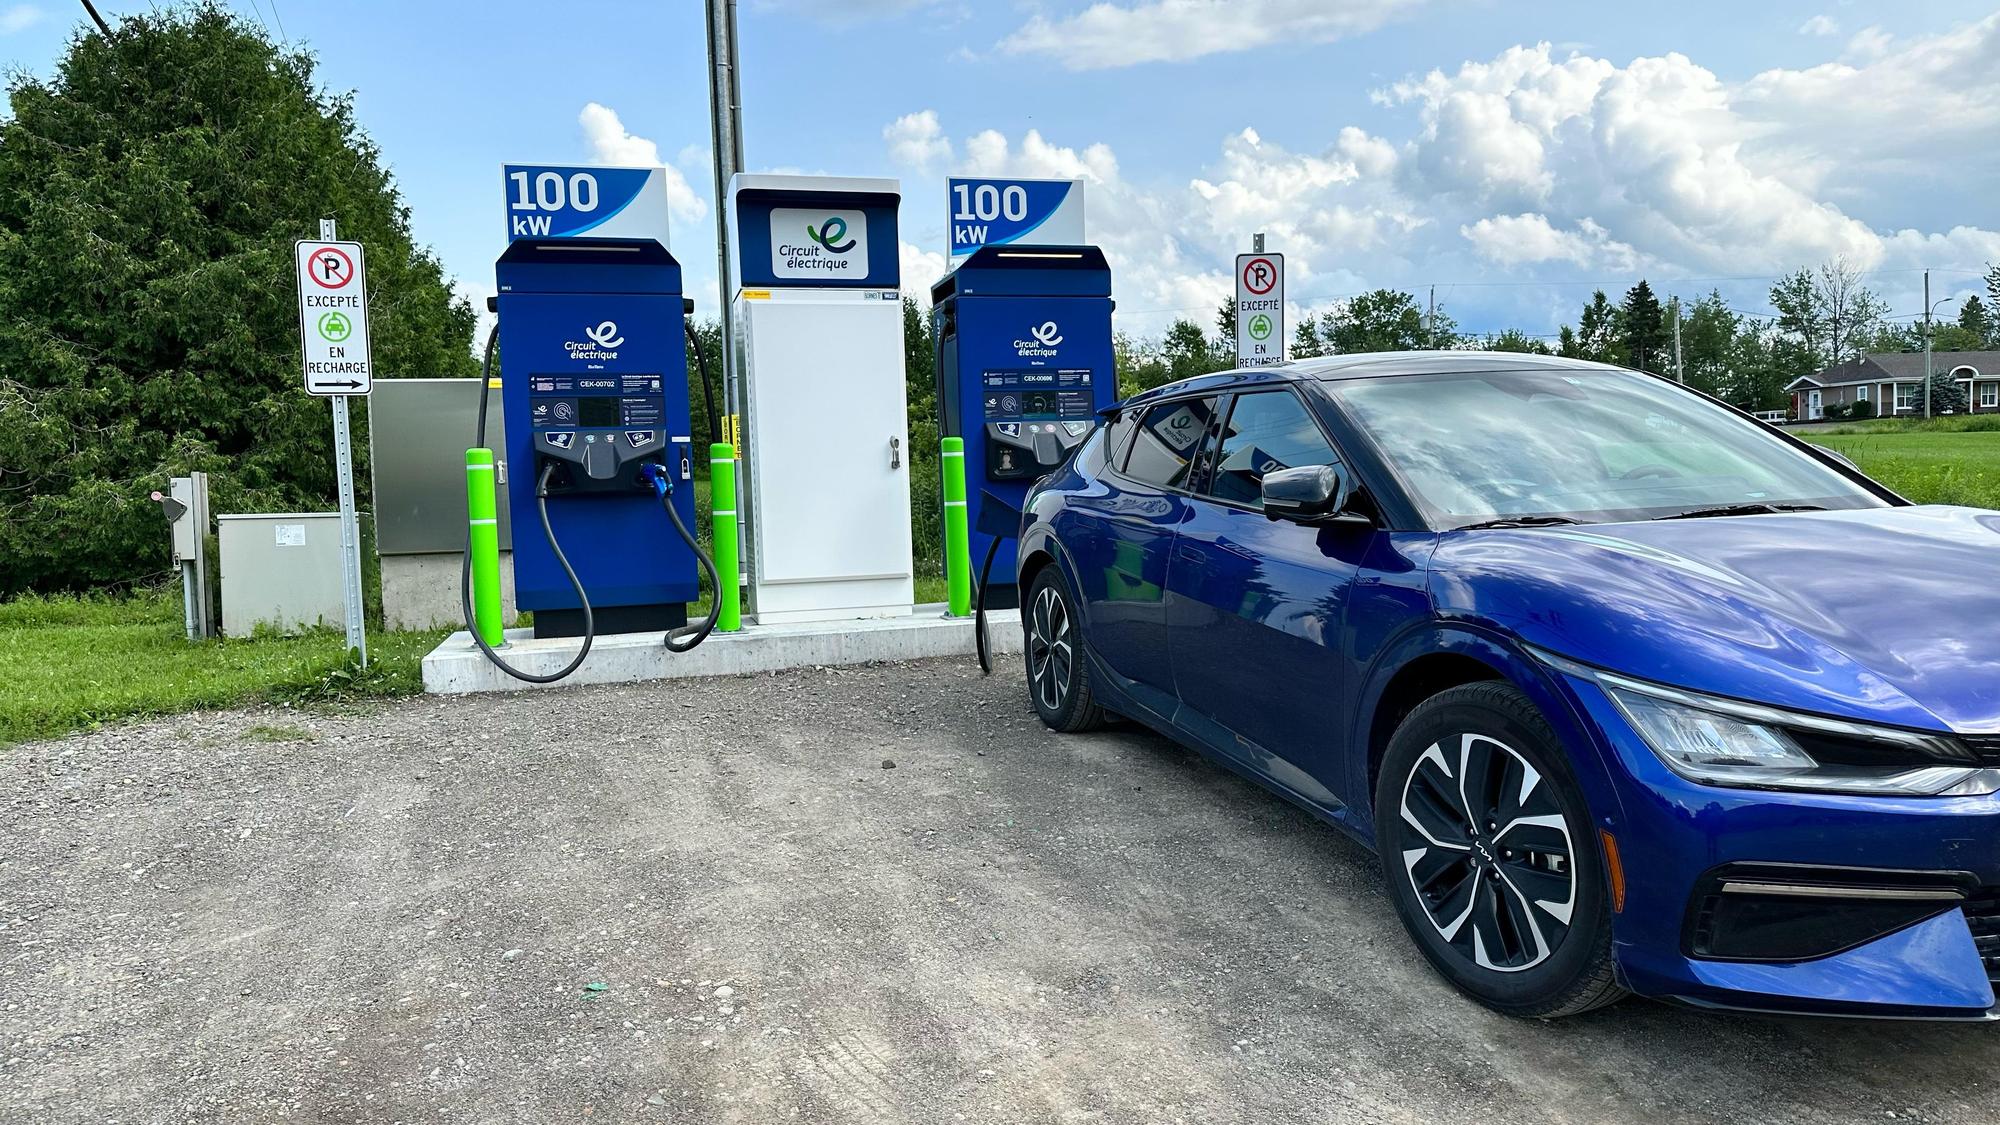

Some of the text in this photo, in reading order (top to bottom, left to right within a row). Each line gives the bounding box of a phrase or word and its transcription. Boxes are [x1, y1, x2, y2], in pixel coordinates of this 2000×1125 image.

[510, 171, 599, 213] 100
[954, 184, 1028, 222] 100
[513, 215, 552, 236] kW
[955, 225, 988, 245] kW
[779, 245, 820, 257] Circuit
[786, 257, 848, 271] électrique
[307, 295, 359, 307] EXCEPTÉ
[1241, 299, 1279, 311] EXCEPTÉ
[564, 341, 597, 351] Circuit
[1013, 340, 1040, 348] Circuit
[1255, 344, 1266, 354] EN
[329, 347, 345, 358] EN
[570, 349, 618, 361] électrique
[1018, 347, 1058, 358] électrique
[309, 362, 367, 374] RECHARGE
